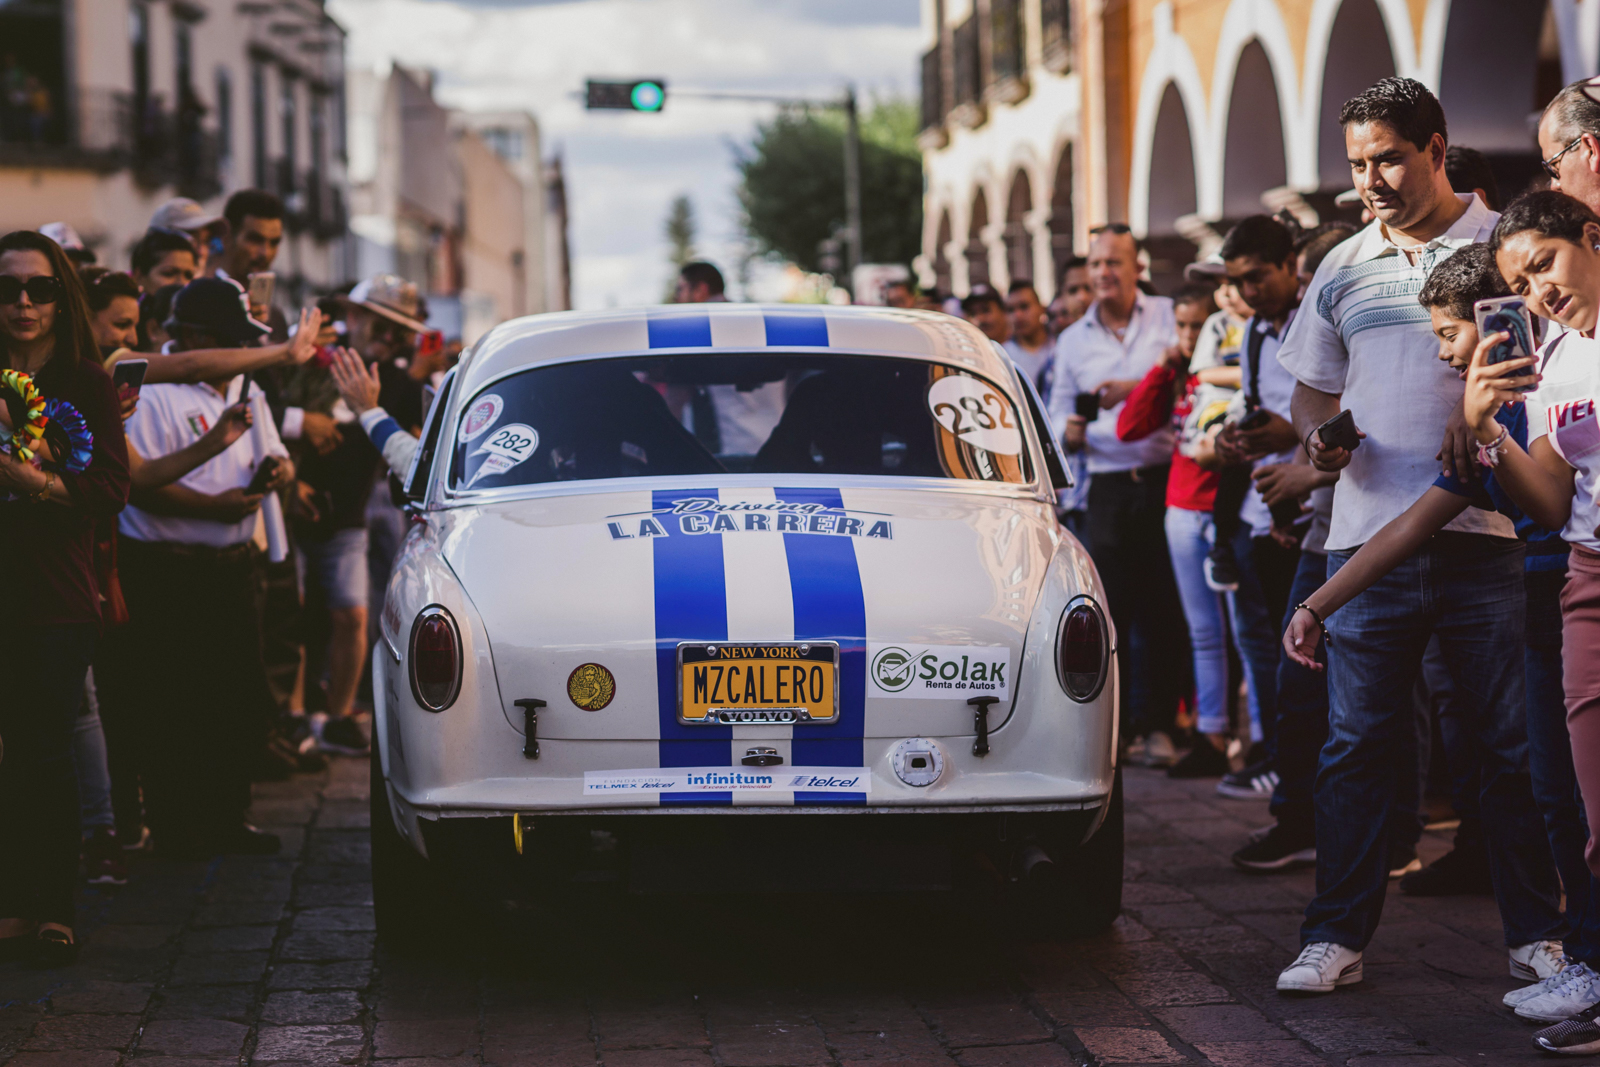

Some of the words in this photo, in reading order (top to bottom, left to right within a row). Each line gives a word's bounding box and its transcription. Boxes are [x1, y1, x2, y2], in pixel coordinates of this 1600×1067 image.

[933, 393, 1014, 436] 282
[491, 430, 532, 454] 282
[672, 498, 827, 514] Driving
[606, 517, 668, 541] LA
[680, 513, 894, 541] CARRERA
[720, 647, 756, 659] NEW
[760, 647, 800, 659] YORK
[693, 665, 824, 704] MZCALERO
[925, 680, 953, 689] Renta
[955, 681, 967, 690] de
[969, 681, 996, 690] Autos
[726, 711, 794, 722] VOLVO
[641, 781, 675, 789] telcel
[687, 772, 773, 785] infinitum
[807, 776, 860, 788] telcel
